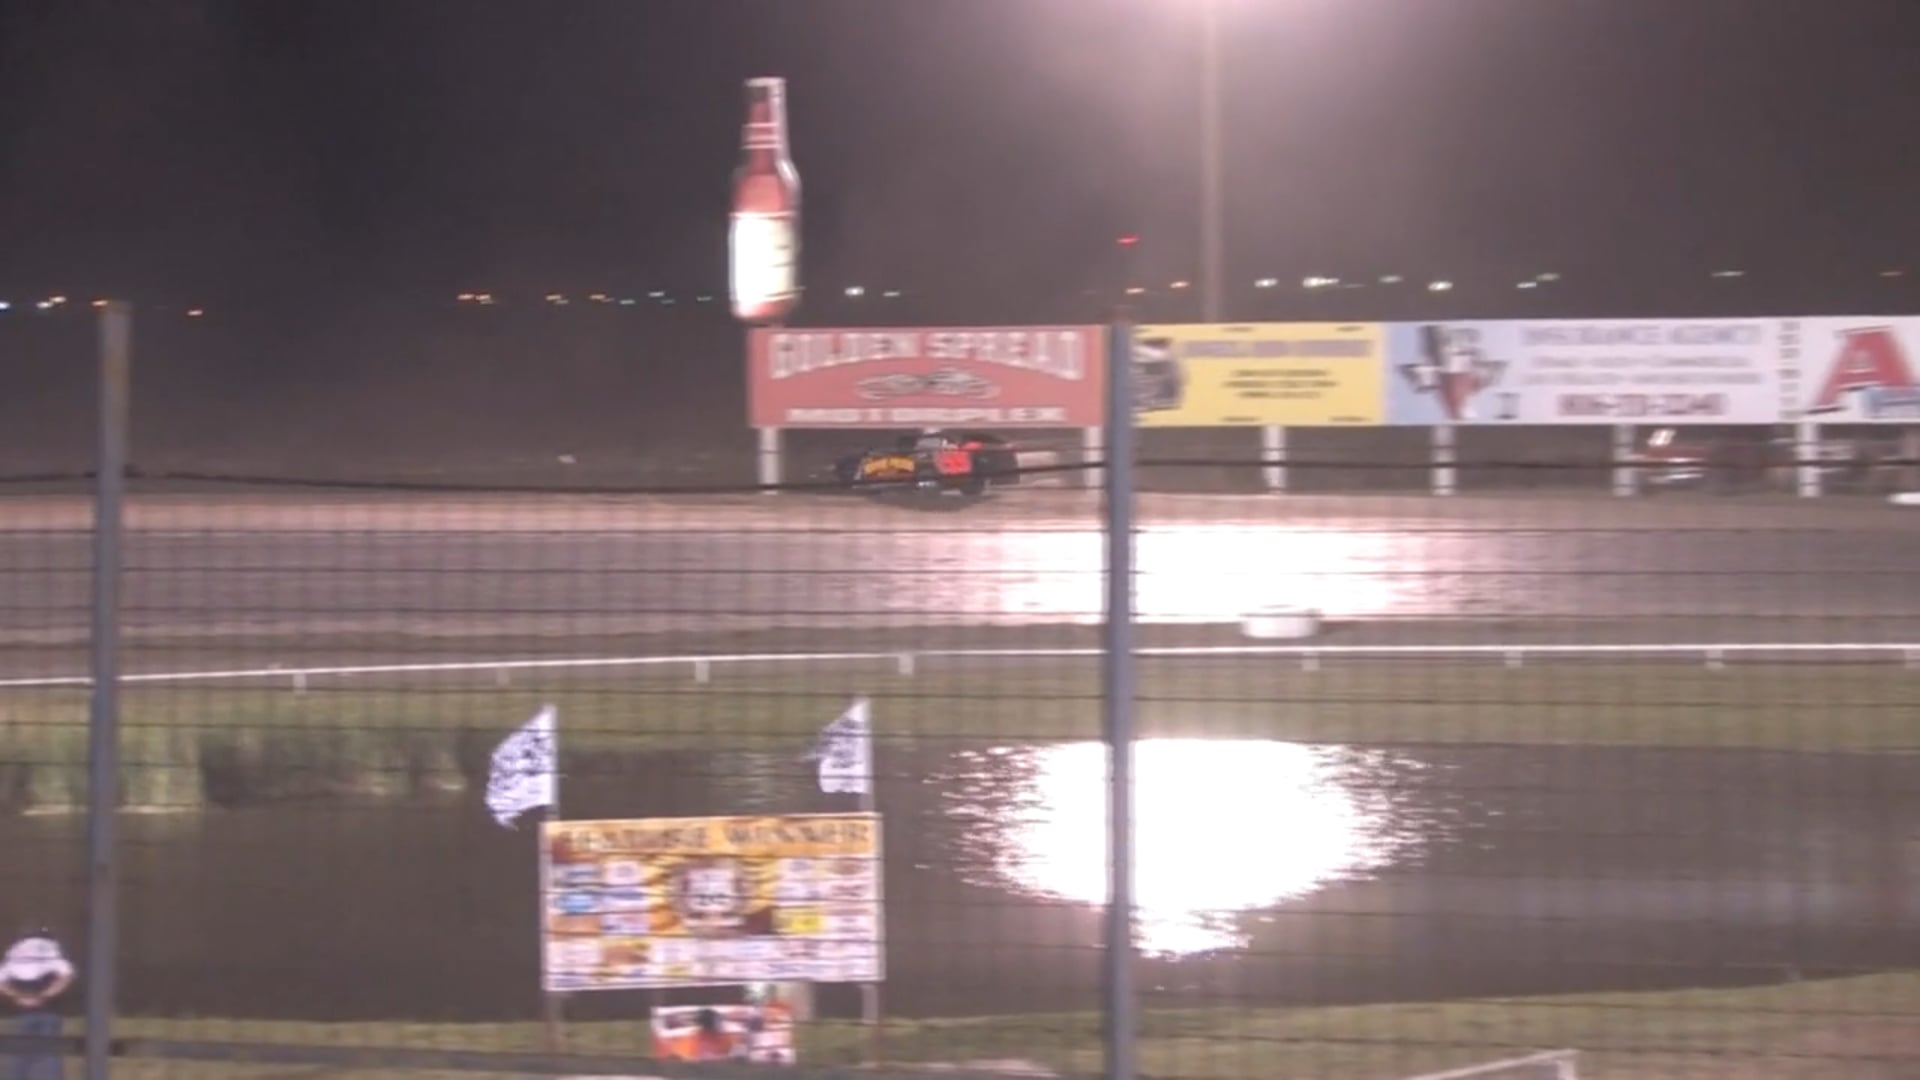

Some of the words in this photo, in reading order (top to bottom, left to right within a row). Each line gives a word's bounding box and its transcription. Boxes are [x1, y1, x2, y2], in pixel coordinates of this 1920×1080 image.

[770, 332, 918, 378] GOLDEN
[927, 330, 1084, 380] SPREAD
[559, 827, 706, 849] FEATURE
[725, 820, 869, 845] WINNER
